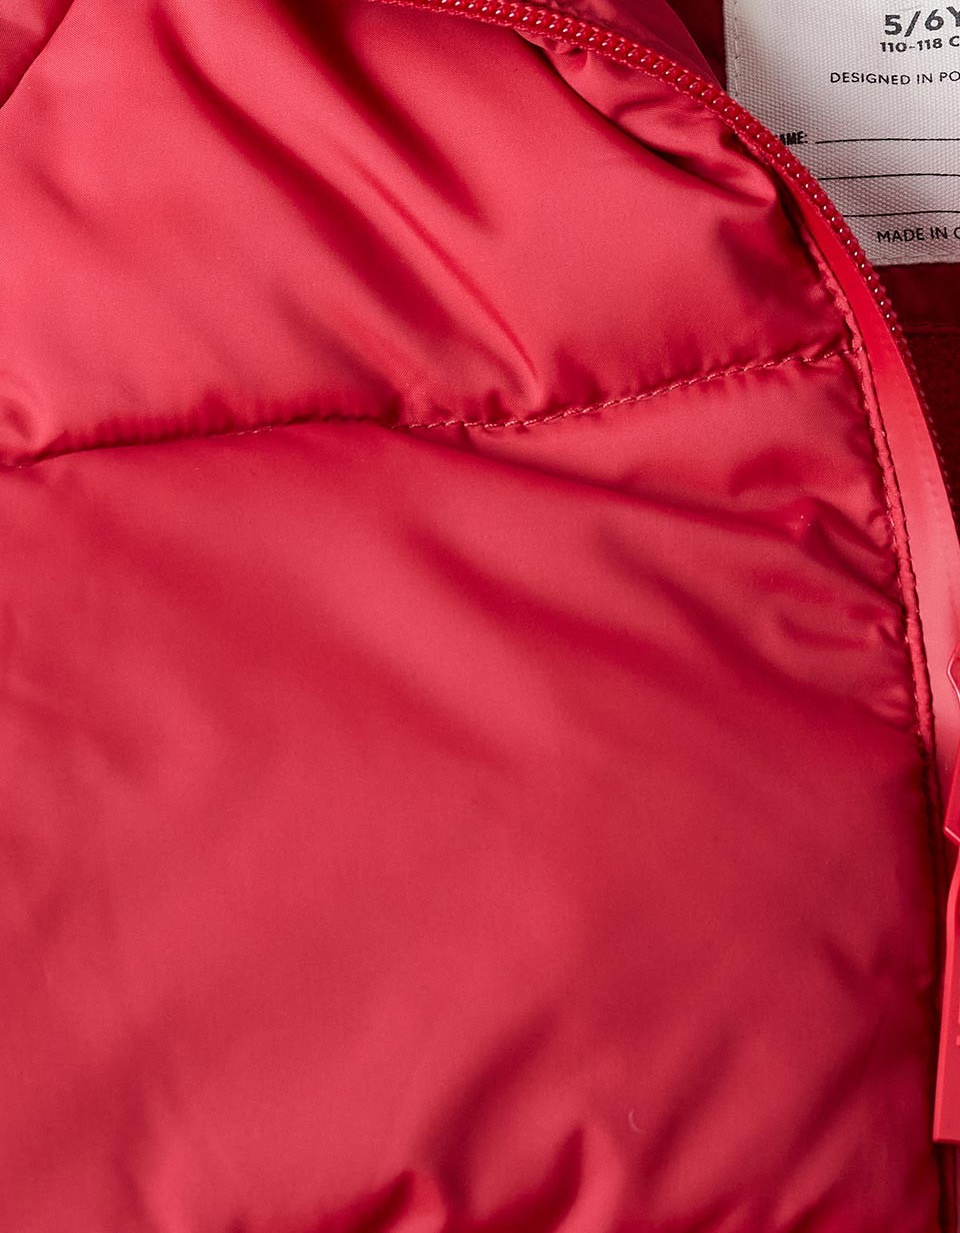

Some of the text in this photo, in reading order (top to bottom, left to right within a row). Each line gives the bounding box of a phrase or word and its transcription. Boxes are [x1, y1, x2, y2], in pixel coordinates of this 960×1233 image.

[880, 37, 943, 53] 110-118
[830, 72, 911, 85] DESIGNED
[916, 73, 933, 85] IN
[776, 130, 808, 146] AME:
[876, 227, 925, 243] MADE
[930, 226, 948, 240] IN
